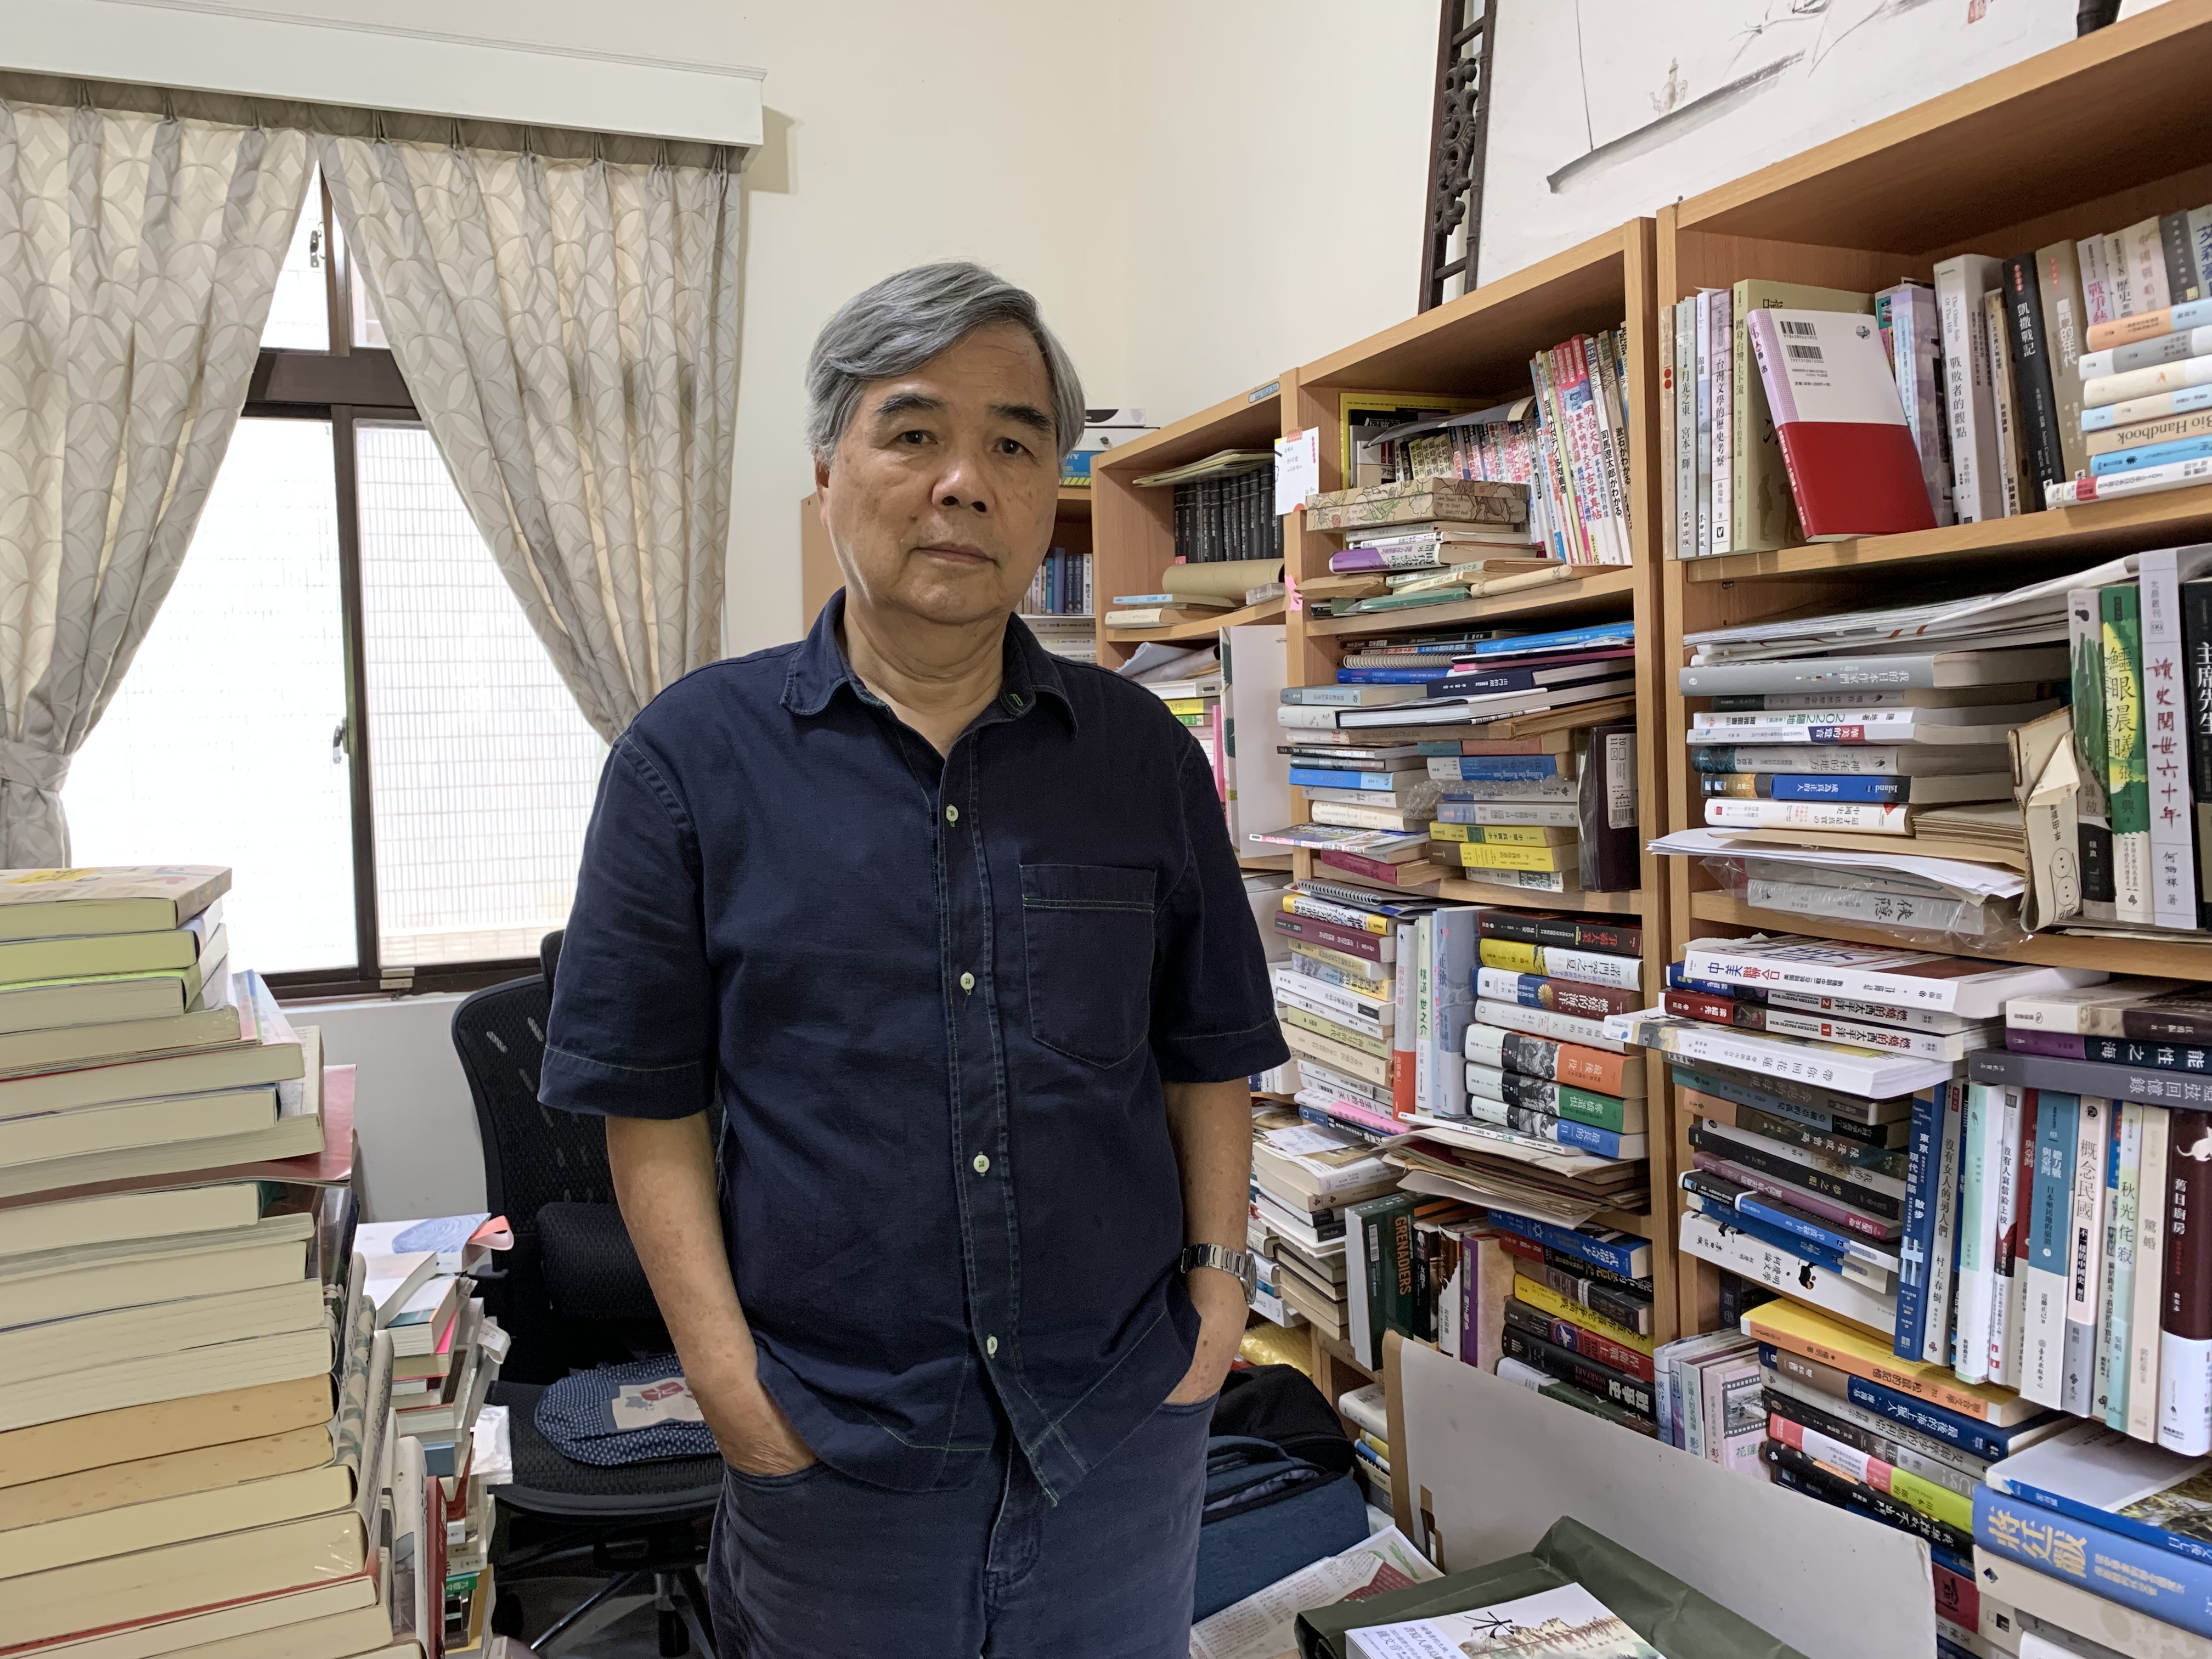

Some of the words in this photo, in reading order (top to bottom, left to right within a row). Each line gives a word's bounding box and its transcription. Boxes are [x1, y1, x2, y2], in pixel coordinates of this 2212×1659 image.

[2016, 302, 2036, 358] 凱撒戰記
[1949, 356, 1967, 439] 戰敗者的觀點
[1716, 358, 1725, 467] 台灣文學的歷史考察
[1583, 404, 1602, 456] 明治天皇
[2116, 419, 2188, 445] Handbook
[1600, 430, 1624, 519] 司馬遼太郎がわかる。
[1839, 670, 1910, 685] 我的日本作家們
[2110, 646, 2137, 760] 鱷眼晨曦
[2146, 657, 2181, 829] 讀史閱世六十年
[1810, 758, 1861, 772] 神在的地方
[1796, 783, 1839, 793] 成為真正的人
[1874, 785, 1898, 794] Island
[1874, 895, 1915, 923] 俠隱
[1438, 952, 1448, 988] 正欲
[1707, 962, 1780, 981] 中美聯合
[1835, 998, 1909, 1022] 燃燒的西太平洋
[1835, 1026, 1911, 1050] 燃燒的西太平洋
[1568, 1058, 1604, 1076] 最後一役
[1762, 1055, 1834, 1084] 帶你回花蓮
[2101, 1042, 2205, 1069] 能性之海
[1799, 1131, 1860, 1158] 陳澄波密碼
[1918, 1132, 1930, 1154] 東京
[1938, 1137, 1955, 1239] 沒有女人的男人們
[1999, 1146, 2012, 1226] 沒有人寫信給上校
[2076, 1139, 2097, 1221] 概念民國
[2117, 1181, 2136, 1265] 秋光侘寂
[1395, 1216, 1412, 1296] GRENADIERS
[1932, 1255, 1945, 1304] 村上春樹
[1871, 1368, 1922, 1394] 松鼠的記憶
[1887, 1400, 1959, 1440] 最後的海上獵人
[1736, 1443, 1758, 1458] 花蓮
